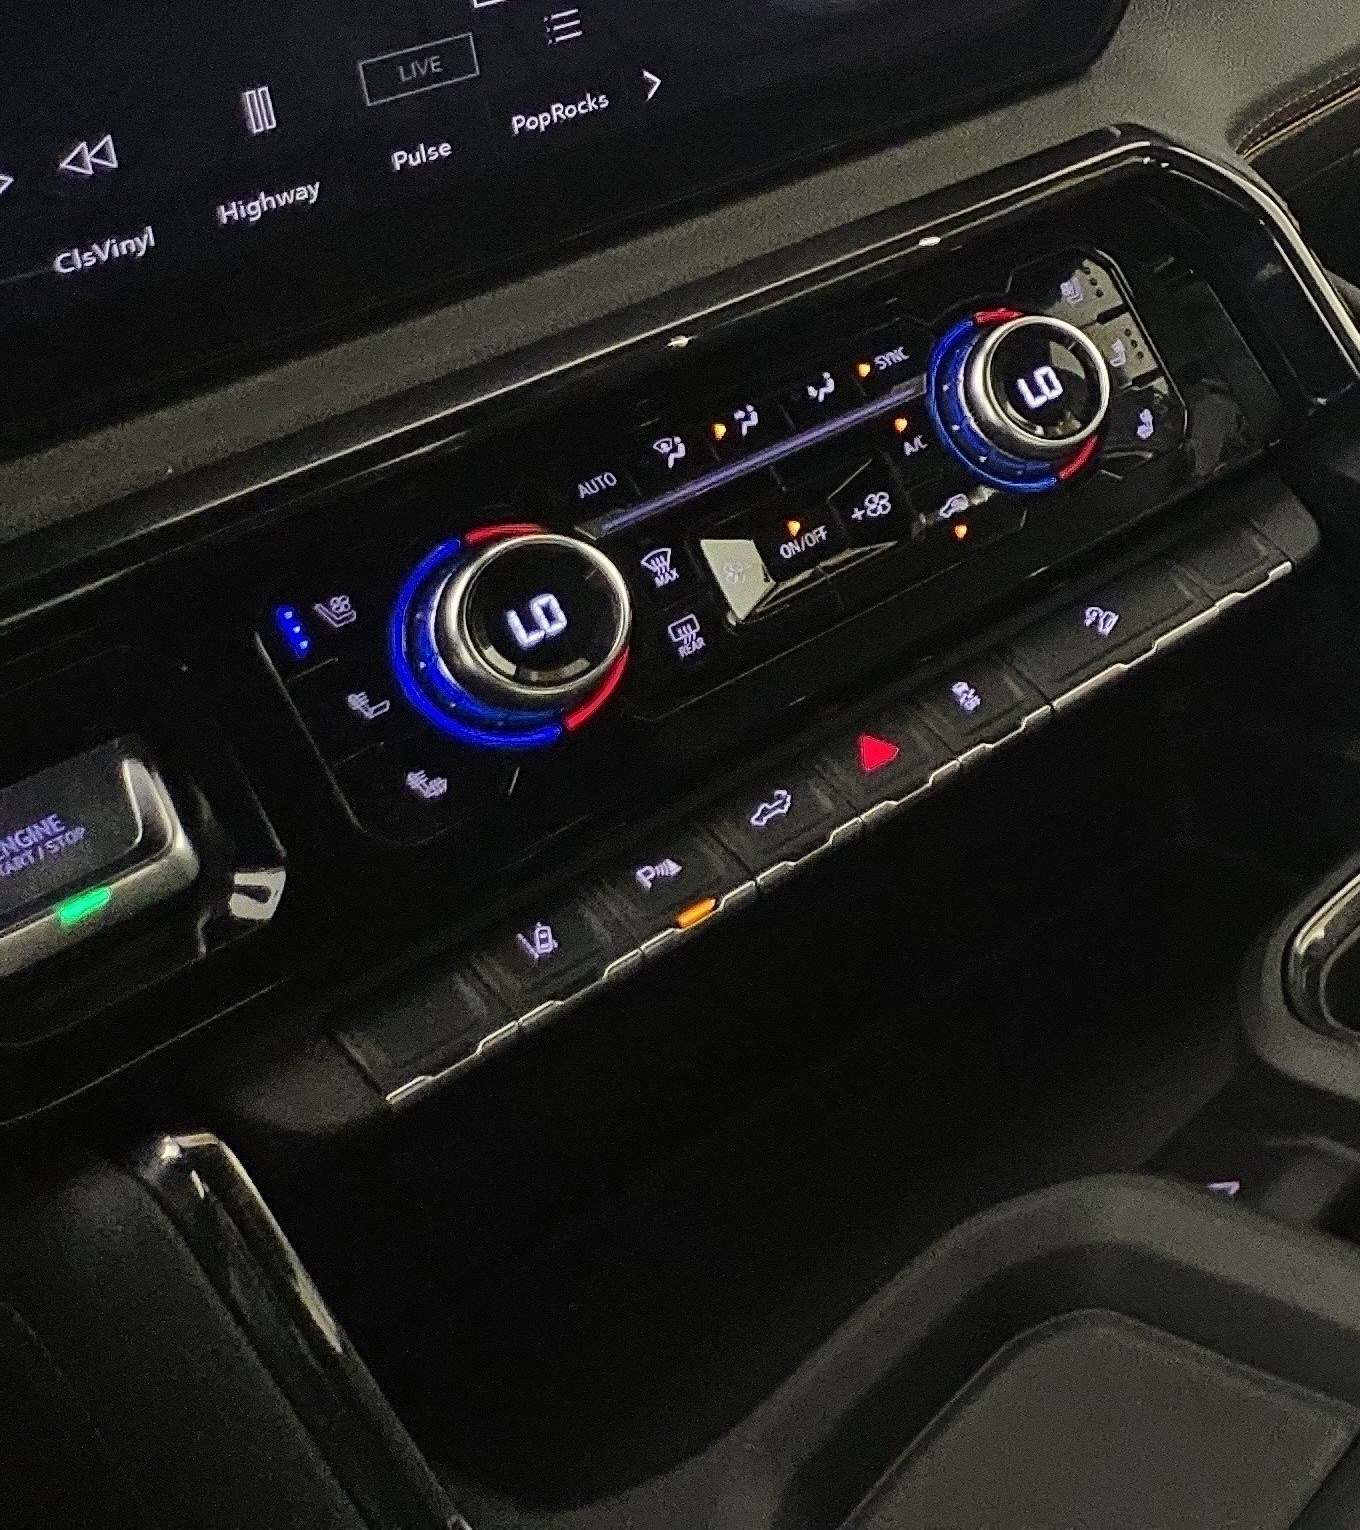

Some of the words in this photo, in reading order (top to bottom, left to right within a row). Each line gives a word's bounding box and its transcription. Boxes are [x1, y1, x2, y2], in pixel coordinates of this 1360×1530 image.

[399, 55, 444, 83] LIVE
[511, 90, 610, 138] PopRocks
[391, 141, 453, 172] Pulse
[216, 181, 321, 227] Highway
[873, 346, 911, 371] SYNC
[1017, 365, 1064, 409] LO
[903, 434, 929, 458] A/C
[576, 471, 618, 500] AUTO
[779, 525, 829, 560] ON/OFF
[653, 567, 681, 589] MAX
[506, 593, 568, 650] LO
[677, 635, 707, 660] REAR
[0, 814, 66, 862] NGINE
